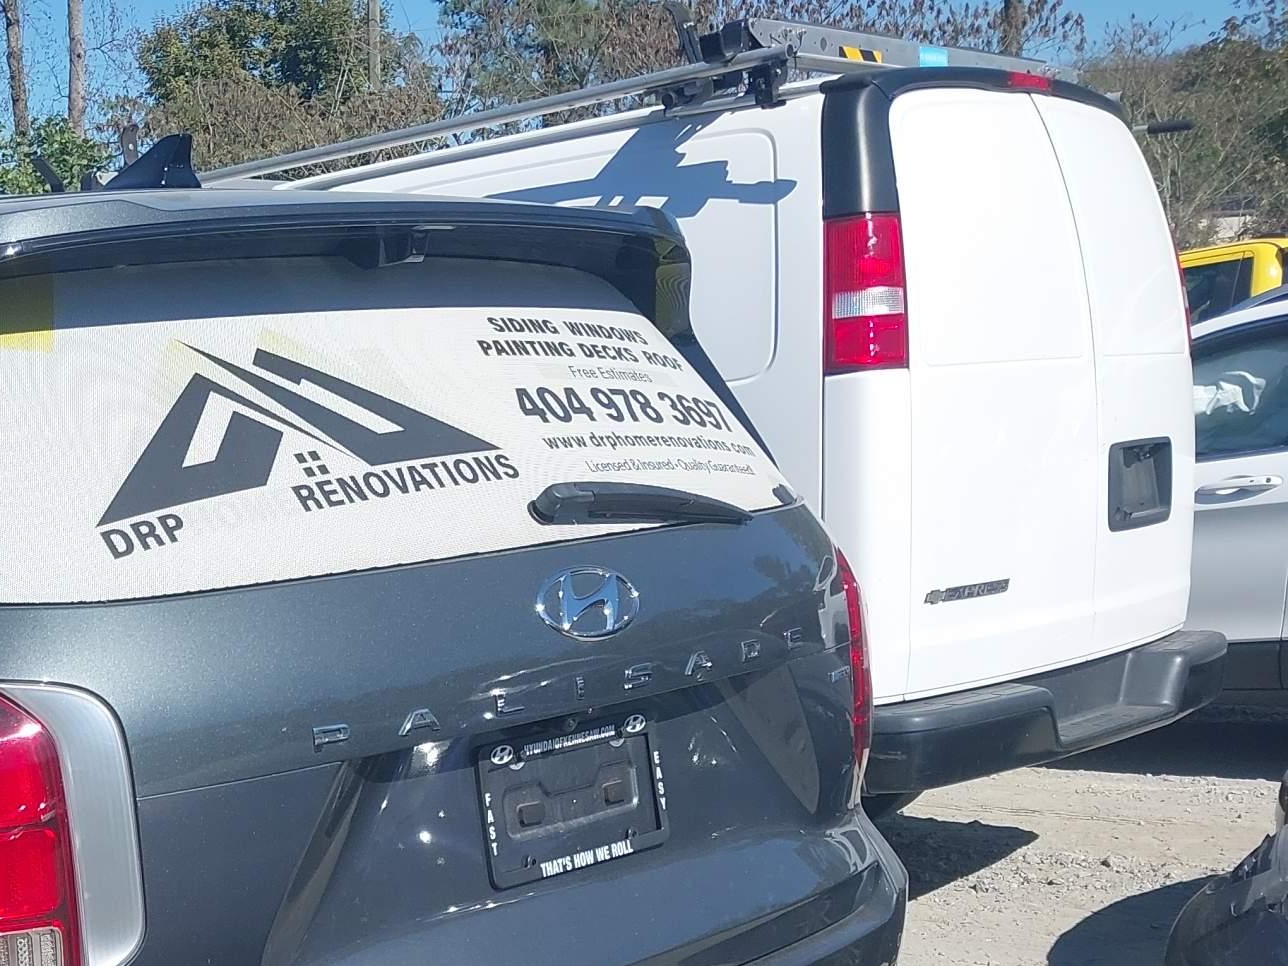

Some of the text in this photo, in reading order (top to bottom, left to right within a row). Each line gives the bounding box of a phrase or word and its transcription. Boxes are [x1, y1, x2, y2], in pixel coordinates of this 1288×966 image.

[487, 316, 649, 346] SIDING WINDOWS
[476, 339, 684, 372] PAINTING DECKS ROOF
[568, 366, 654, 383] Free Estimates
[515, 387, 733, 433] 404 978 3697
[100, 513, 185, 560] DRP
[291, 453, 520, 513] RENOVATIONS
[312, 625, 803, 747] PALISADE
[653, 750, 667, 810] EASY
[484, 793, 498, 857] FAST
[540, 839, 634, 878] THAT'S HOW WE ROLL
